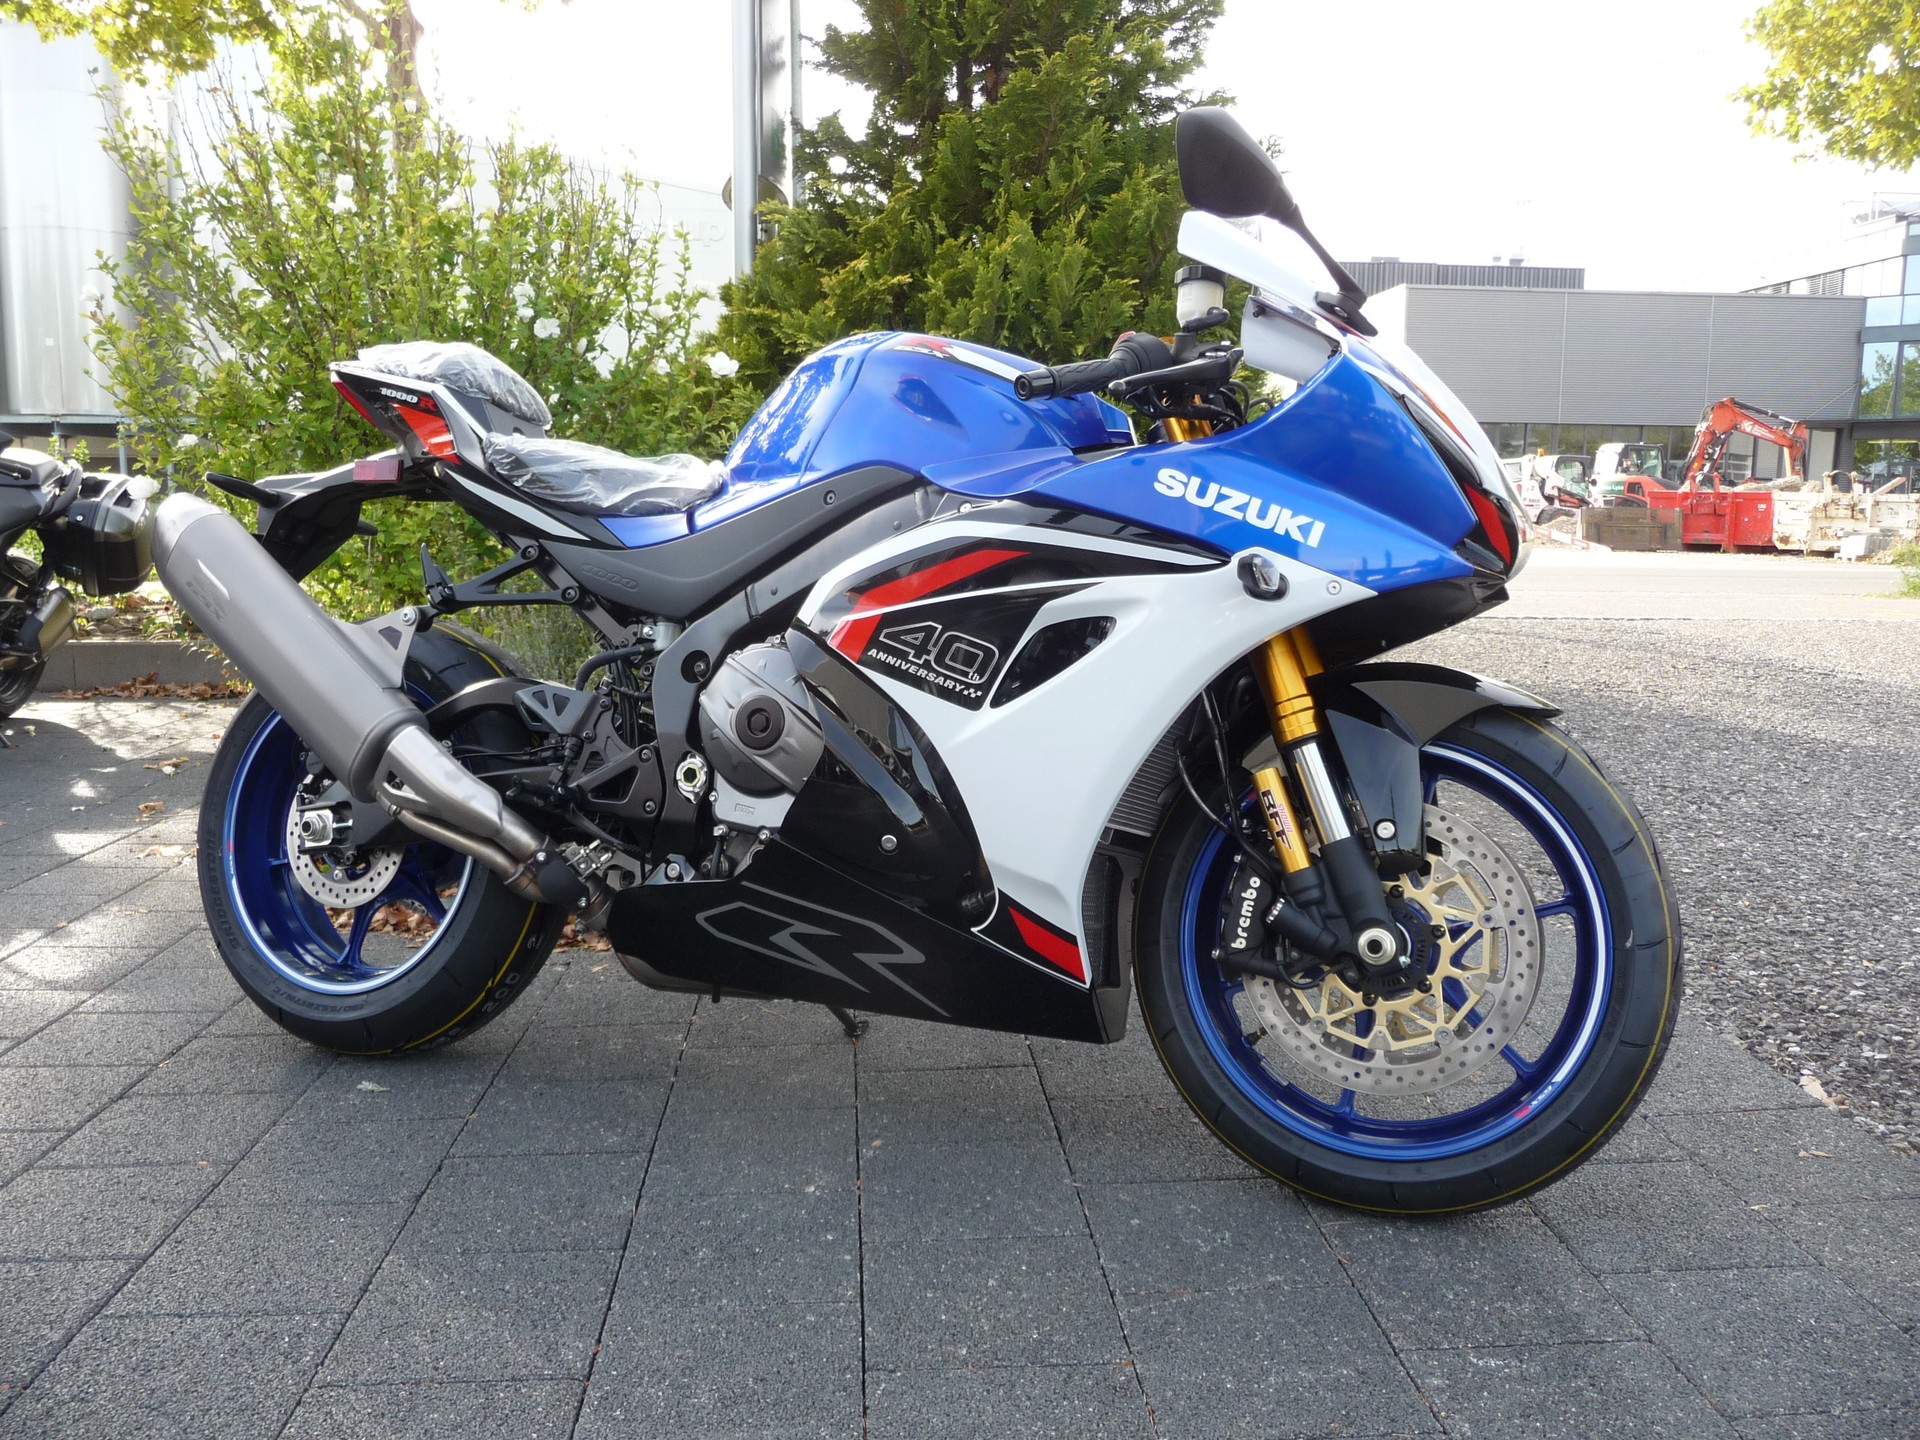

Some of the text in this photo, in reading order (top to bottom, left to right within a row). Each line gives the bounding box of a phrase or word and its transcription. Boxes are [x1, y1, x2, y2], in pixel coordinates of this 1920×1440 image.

[1153, 468, 1326, 549] SUZUKI
[867, 648, 966, 693] ANNIVERSARY
[1230, 876, 1261, 949] brembo
